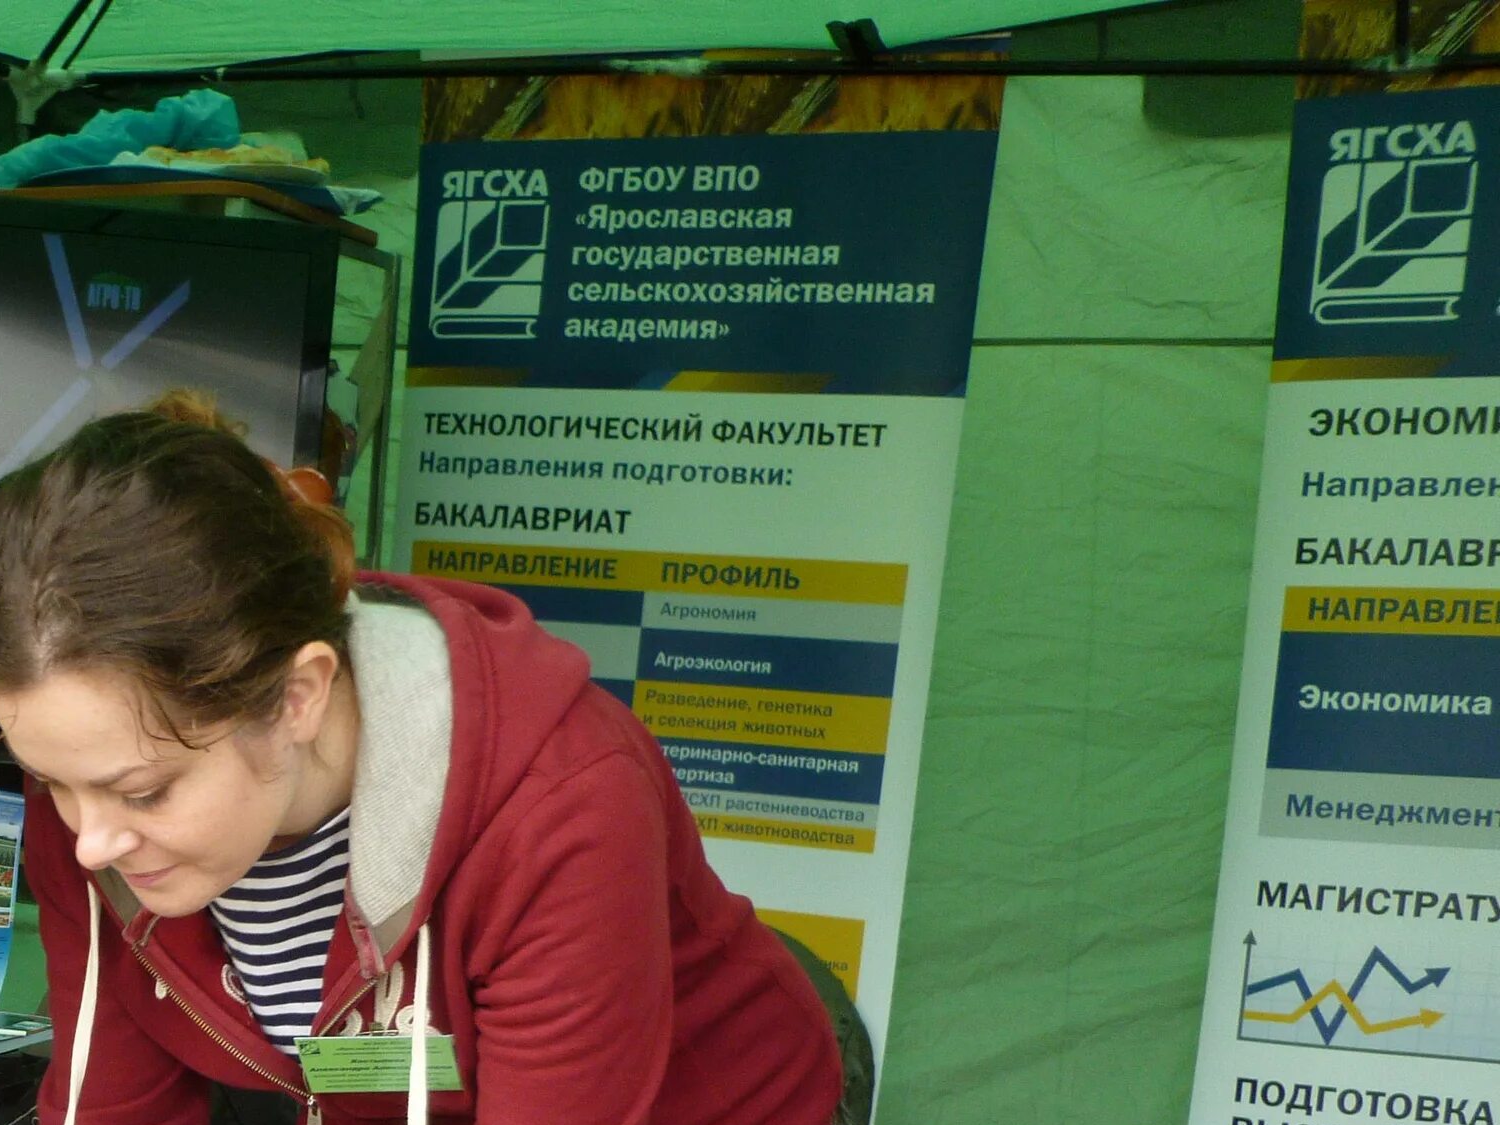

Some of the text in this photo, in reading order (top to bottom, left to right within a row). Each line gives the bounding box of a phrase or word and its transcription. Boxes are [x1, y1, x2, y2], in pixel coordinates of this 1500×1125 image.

[1329, 121, 1477, 162] ЯГСХА
[442, 169, 549, 198] ЯГСХА
[579, 166, 760, 196] ФГБОУ ВПО
[576, 205, 793, 234] «Ярославская
[571, 244, 840, 272] государственная
[568, 278, 936, 305] сельскохозяйственная
[564, 316, 731, 342] академия»
[424, 412, 888, 448] ТЕХНОЛОГИЧЕСКИЙ ФАКУЛЬТЕТ
[419, 451, 794, 487] Направления подготовки:
[414, 502, 632, 535] БАКАЛАВРИАТ
[427, 550, 801, 591] НАПРАВЛЕНИЕ ПРОФИЛЬ
[660, 602, 756, 622] Агрономия
[1308, 597, 1500, 624] НАПРАВЛЕ
[654, 651, 772, 674] Агроэкология
[645, 688, 833, 718] Разведение, генетика
[1298, 685, 1493, 715] Экономика
[658, 715, 736, 733] селекция
[742, 722, 826, 740] животных
[662, 745, 859, 773] теринарно-санитарная
[672, 767, 735, 784] ертиза
[726, 799, 865, 821] растениеводства
[724, 823, 855, 845] животноводства
